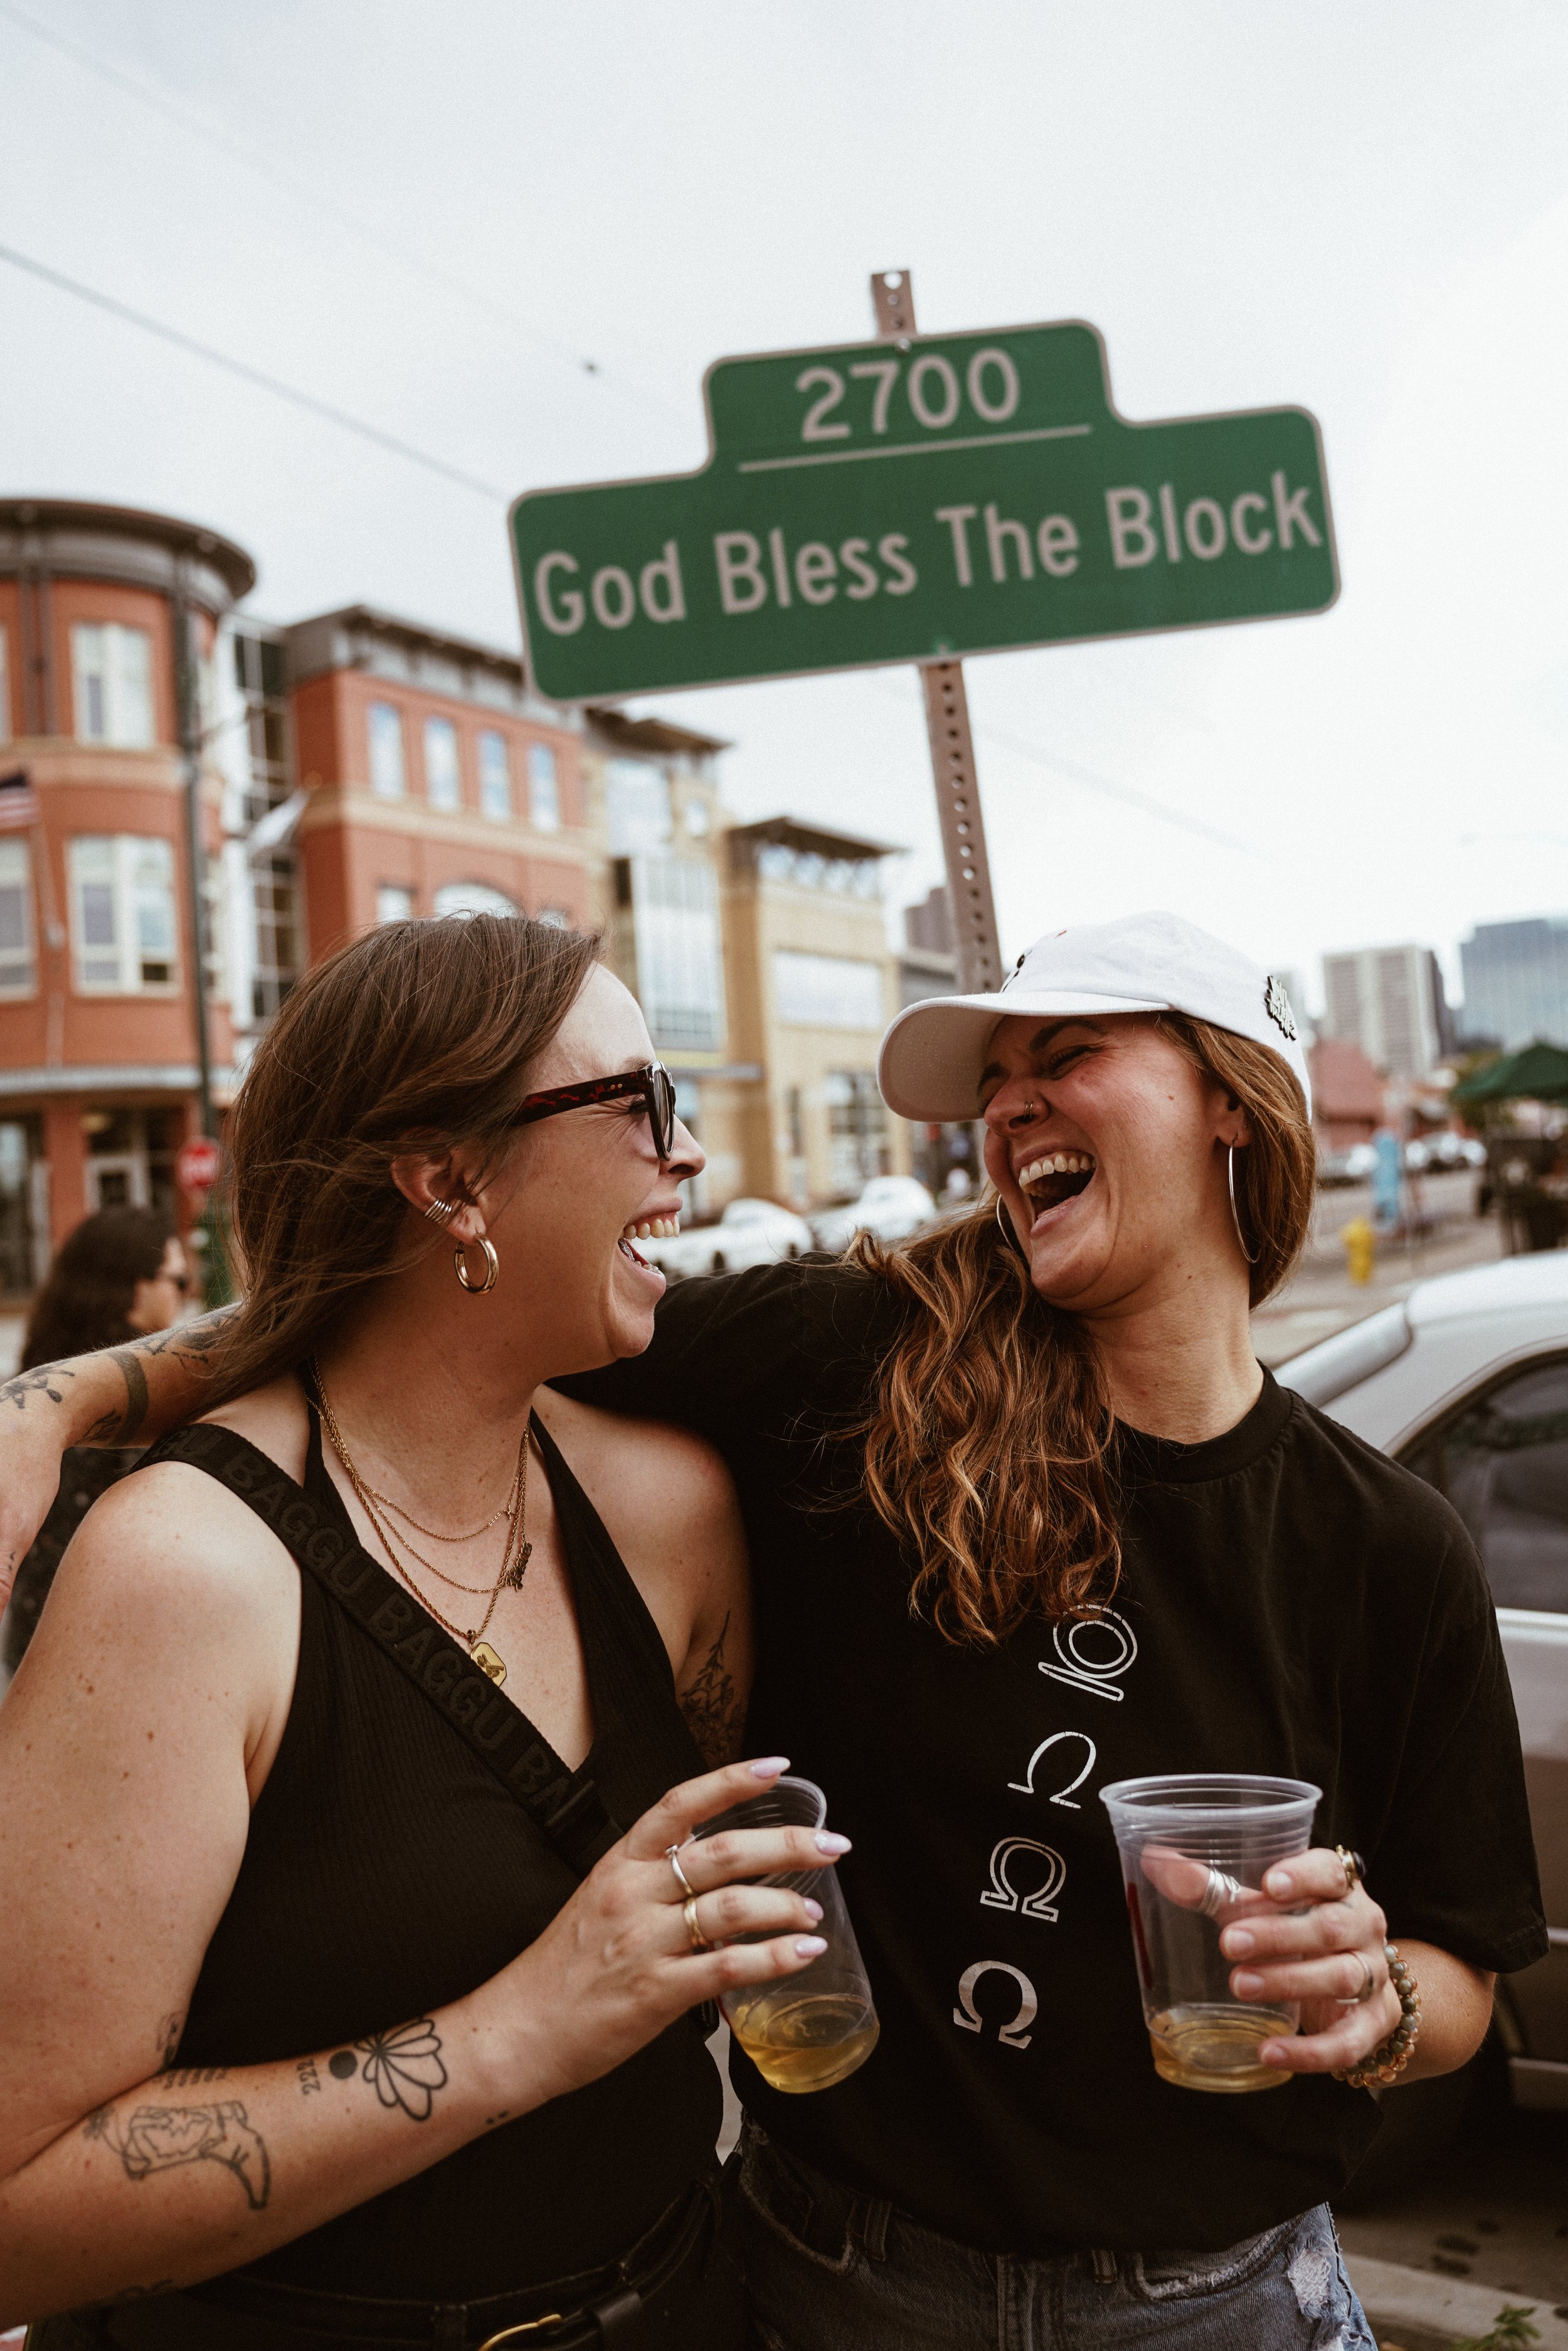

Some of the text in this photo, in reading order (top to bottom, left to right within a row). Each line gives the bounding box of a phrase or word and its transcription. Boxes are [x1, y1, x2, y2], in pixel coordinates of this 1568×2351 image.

[797, 349, 1019, 441] 2700
[536, 473, 1320, 635] God Bless The Block
[221, 1448, 375, 1598] BAGGU
[368, 1592, 518, 1751] BAGGU
[297, 2059, 321, 2095] 222
